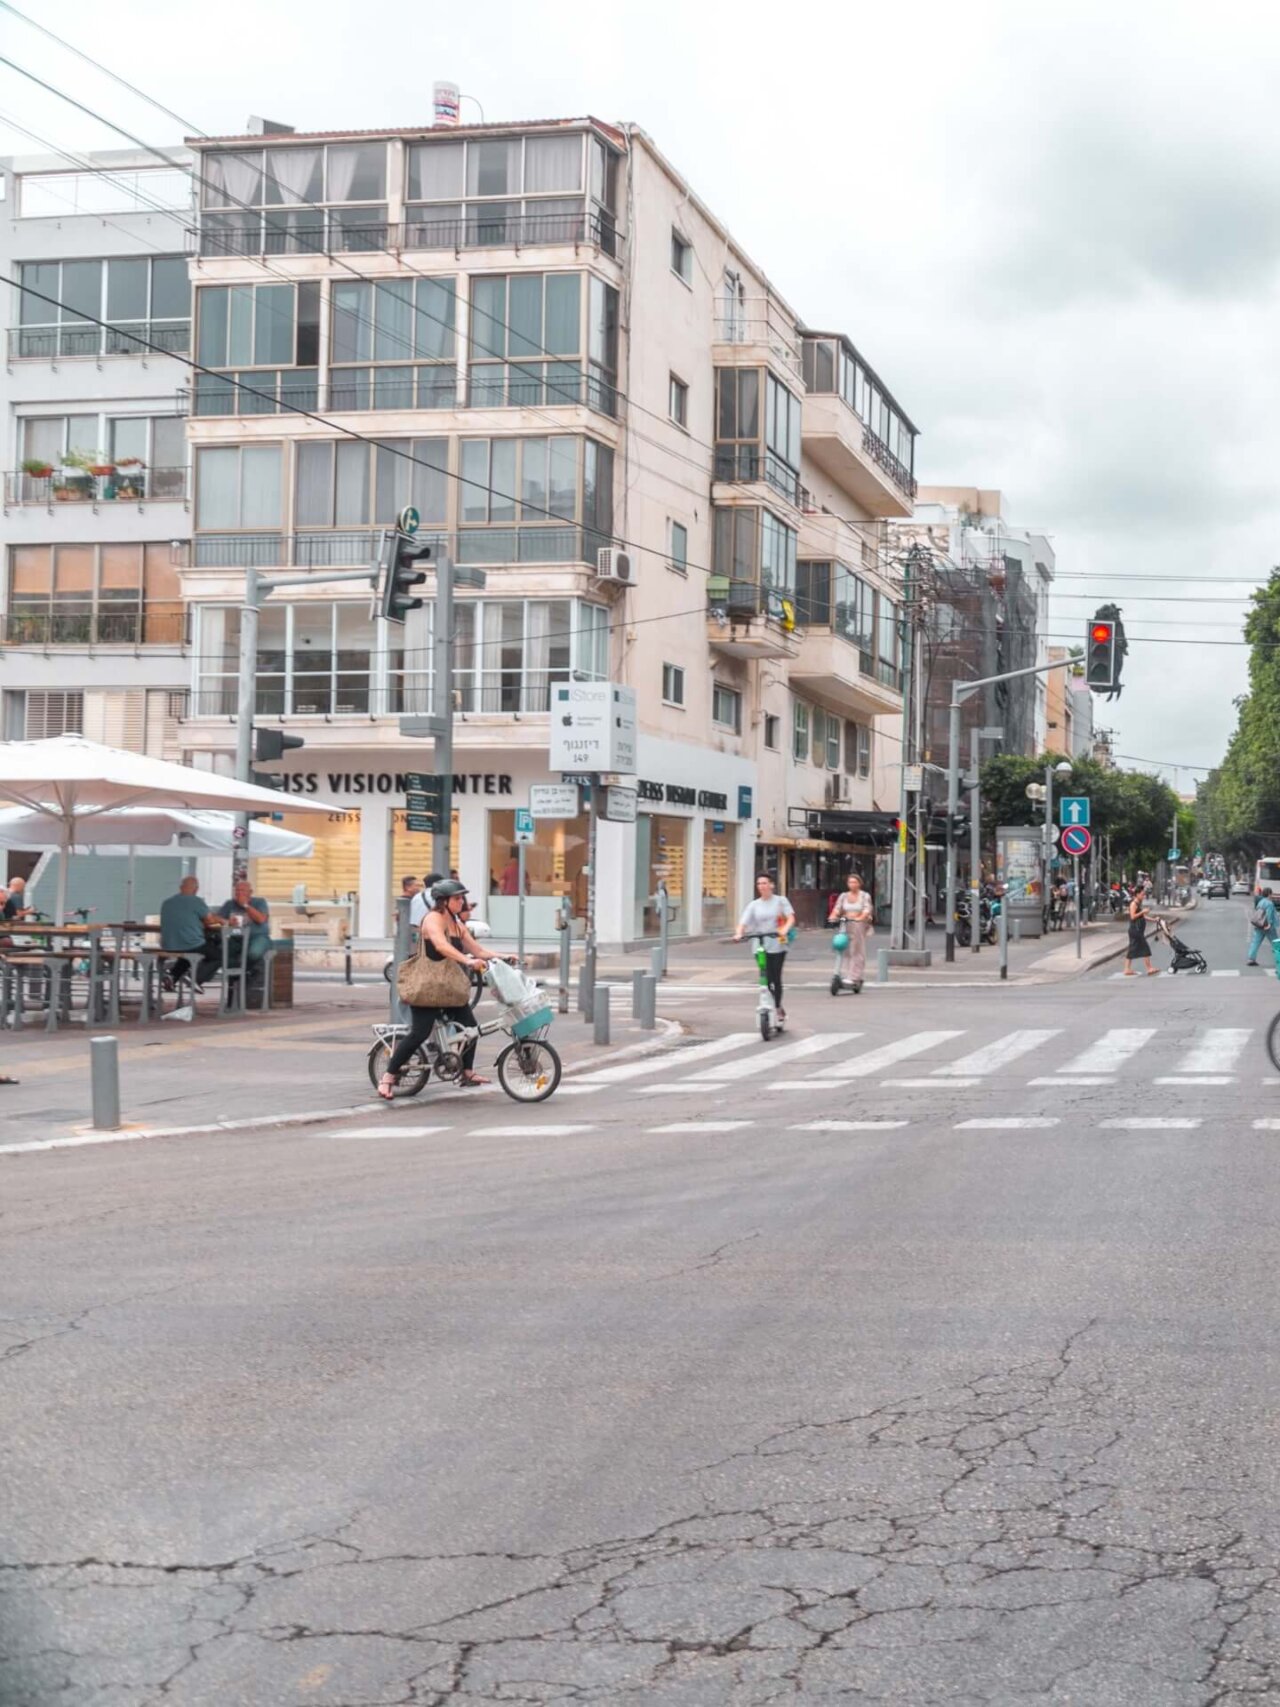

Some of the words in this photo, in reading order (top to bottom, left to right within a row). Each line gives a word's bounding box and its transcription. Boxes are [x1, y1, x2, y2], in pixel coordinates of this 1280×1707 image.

[571, 689, 606, 702] iStore
[563, 740, 599, 752] דיזנגוף
[573, 753, 589, 763] 149
[452, 774, 513, 794] NTER
[638, 779, 664, 801] ZEISS
[666, 784, 696, 806] VISION
[698, 790, 727, 810] CENTER
